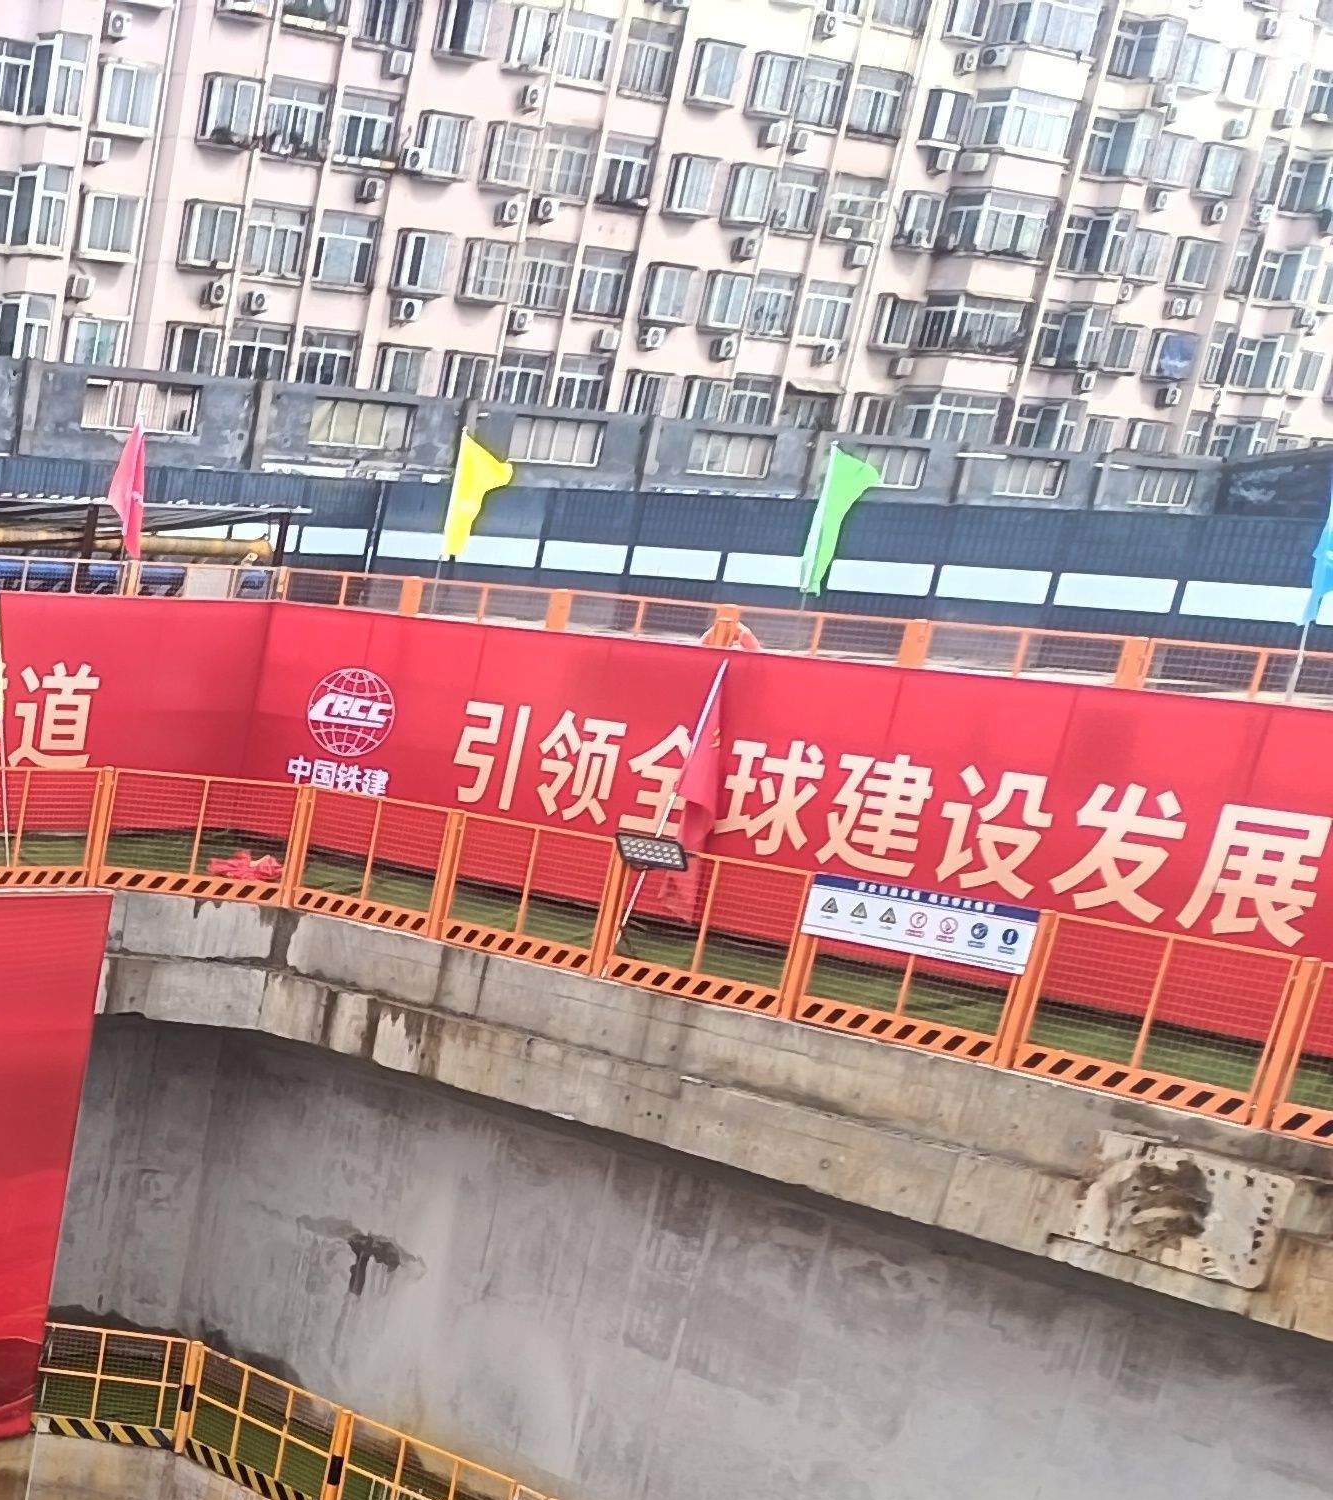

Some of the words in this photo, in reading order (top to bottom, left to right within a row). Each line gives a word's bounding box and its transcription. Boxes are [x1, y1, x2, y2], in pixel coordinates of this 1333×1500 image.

[287, 754, 389, 796] 中国铁建
[453, 700, 1333, 948] 引领全球建设发展
